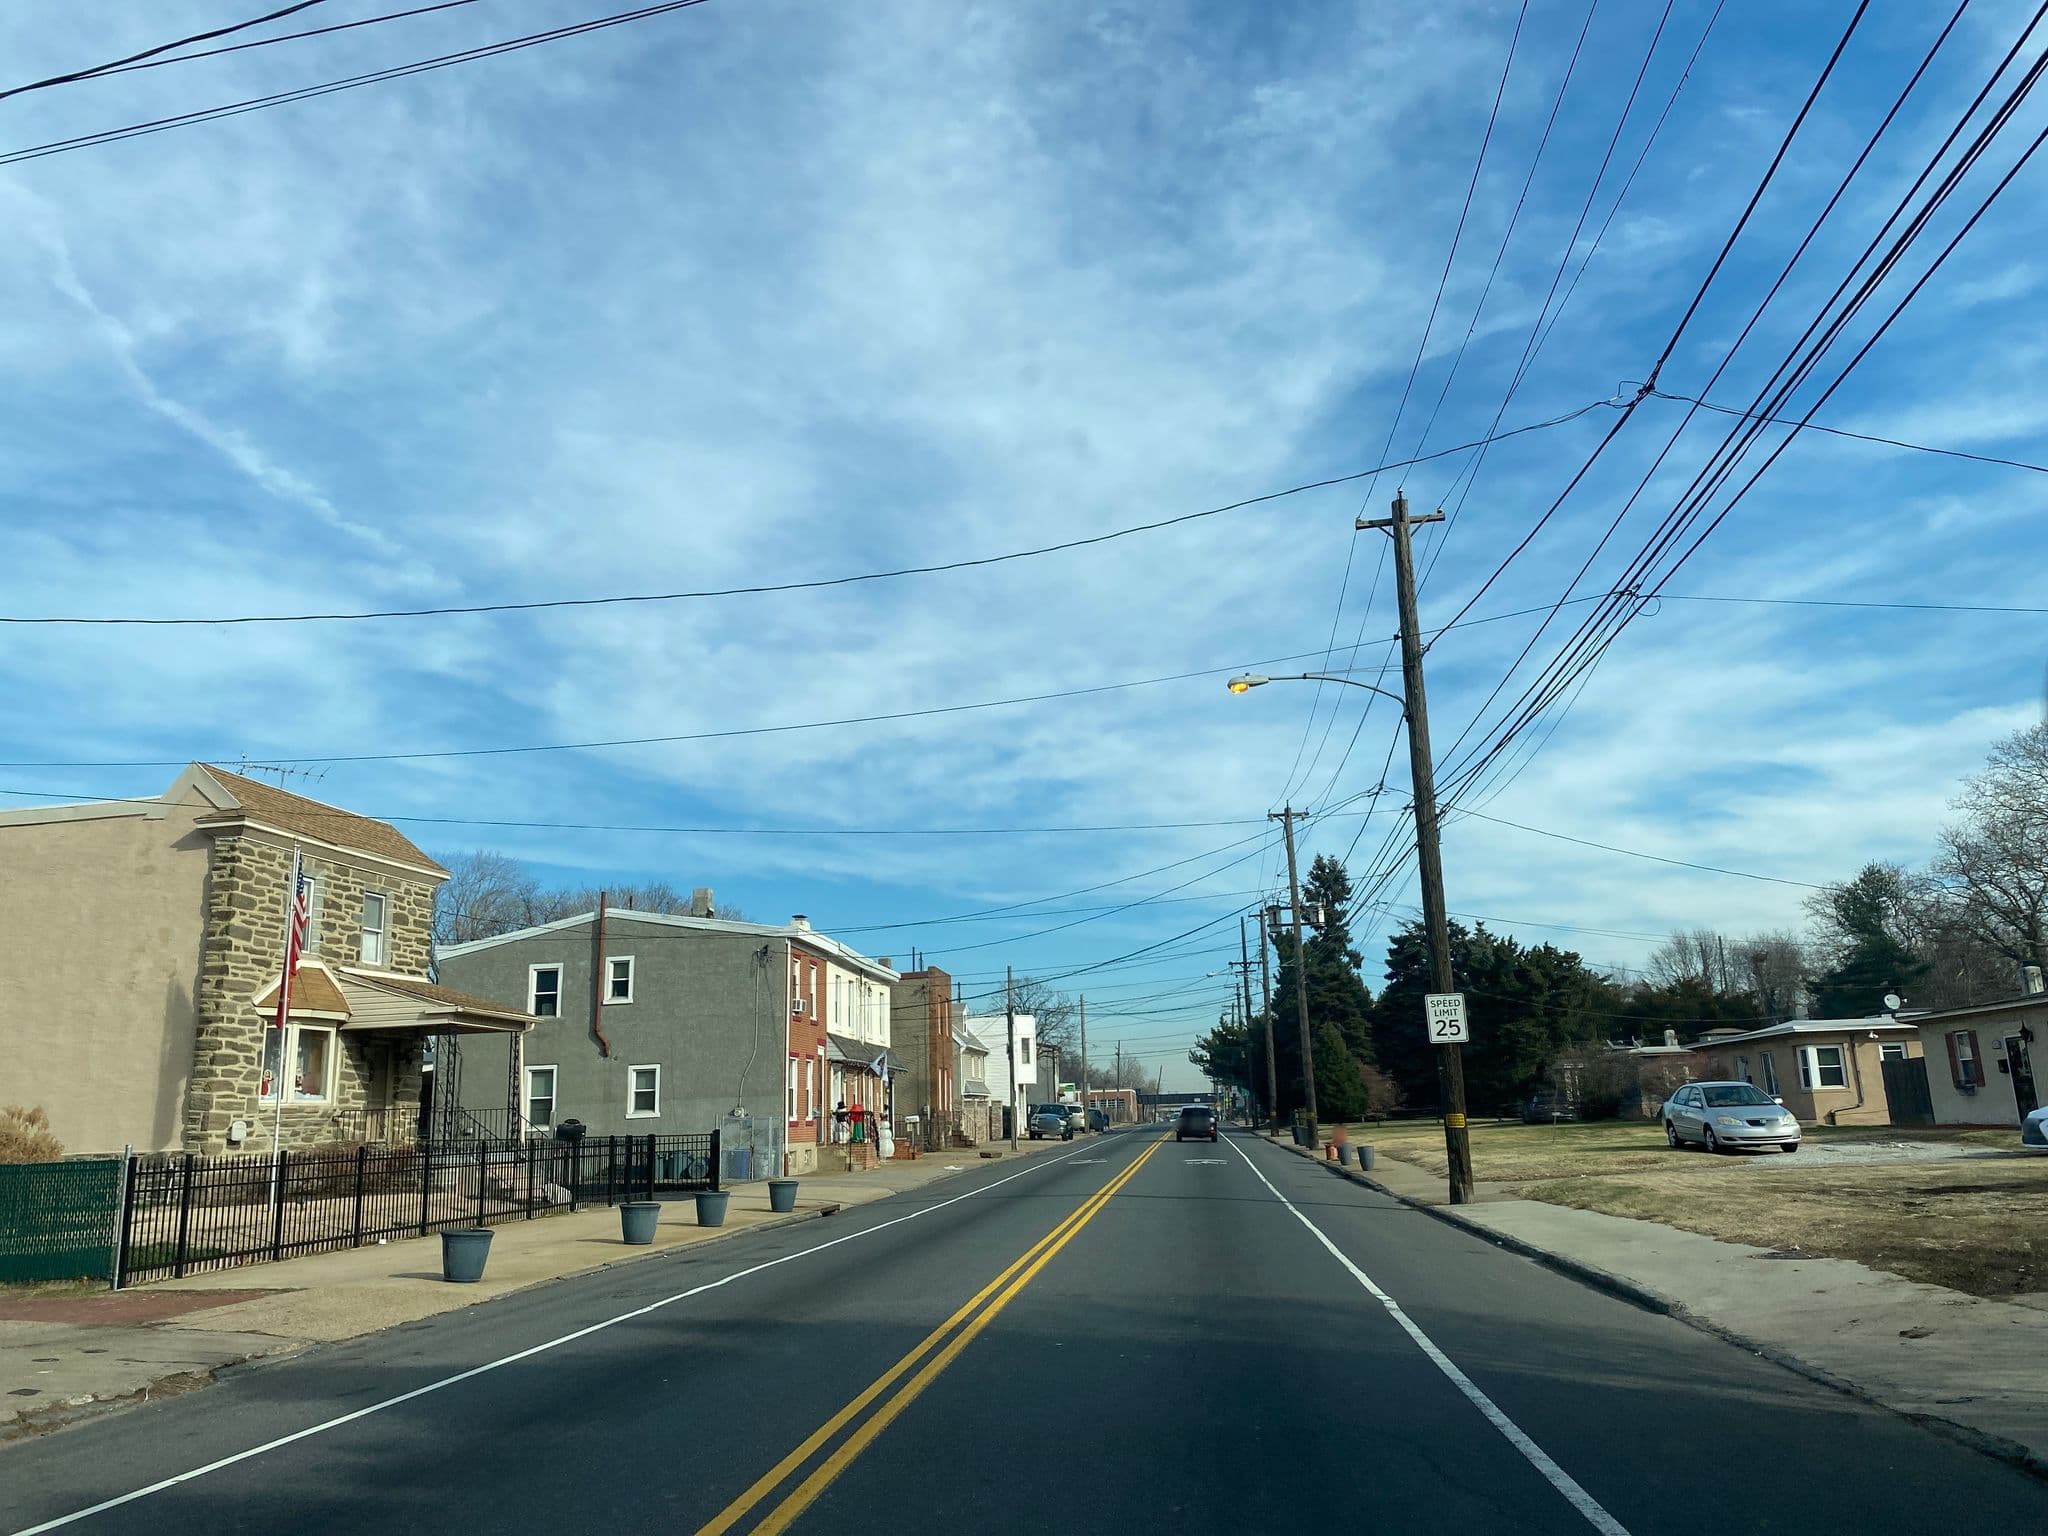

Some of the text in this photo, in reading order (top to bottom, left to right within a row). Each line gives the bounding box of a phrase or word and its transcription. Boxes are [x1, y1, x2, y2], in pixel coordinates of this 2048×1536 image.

[1430, 999, 1461, 1008] SPEED
[1434, 1008, 1458, 1017] LIMIT
[1435, 1019, 1461, 1037] 25
